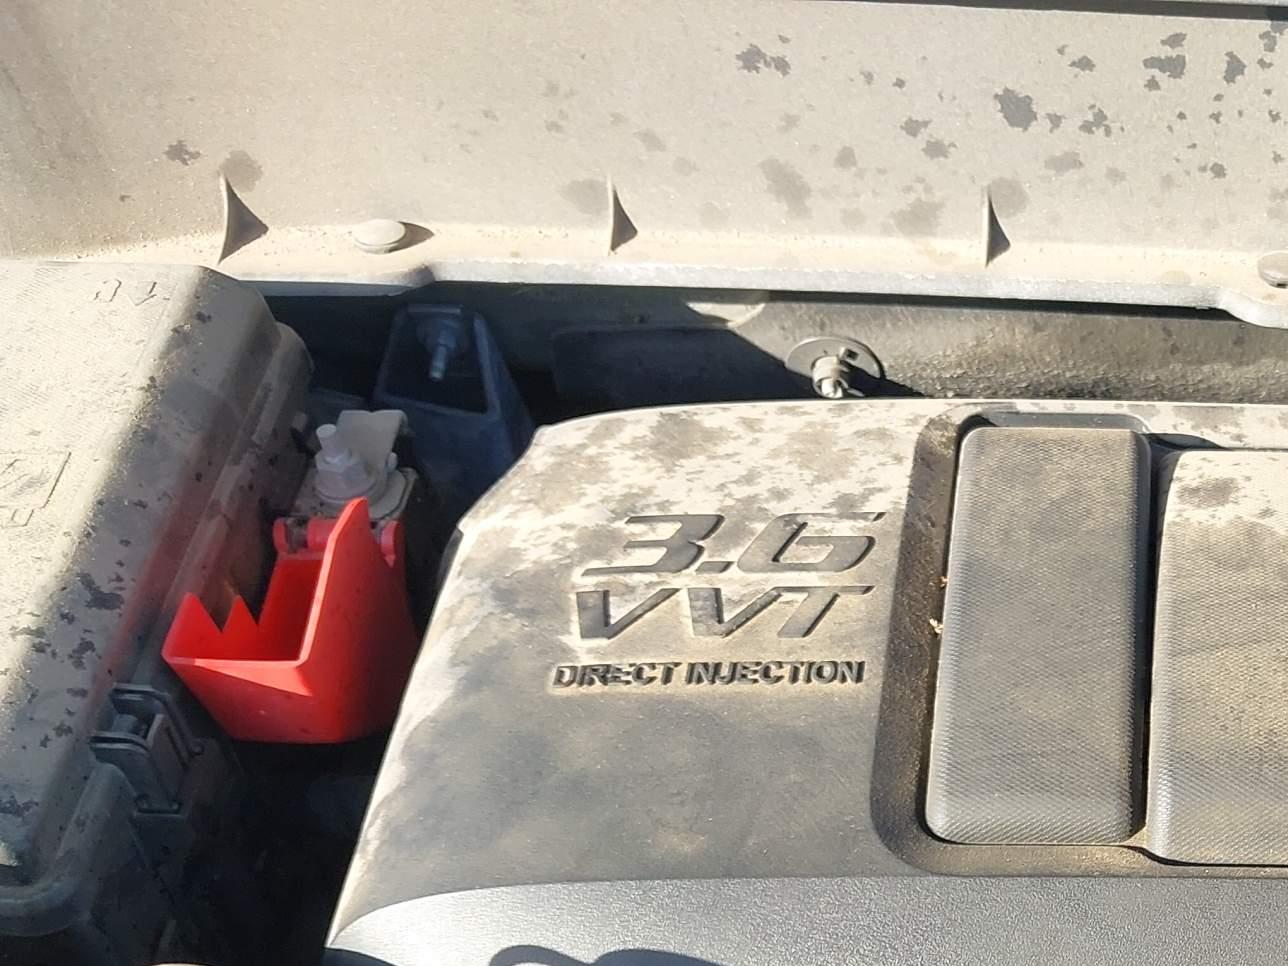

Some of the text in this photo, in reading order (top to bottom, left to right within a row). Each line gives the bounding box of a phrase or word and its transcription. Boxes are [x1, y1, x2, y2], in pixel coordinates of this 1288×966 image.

[581, 511, 887, 577] 3.6
[575, 585, 876, 641] VVT
[551, 660, 867, 689] DIRECT INJECTION
